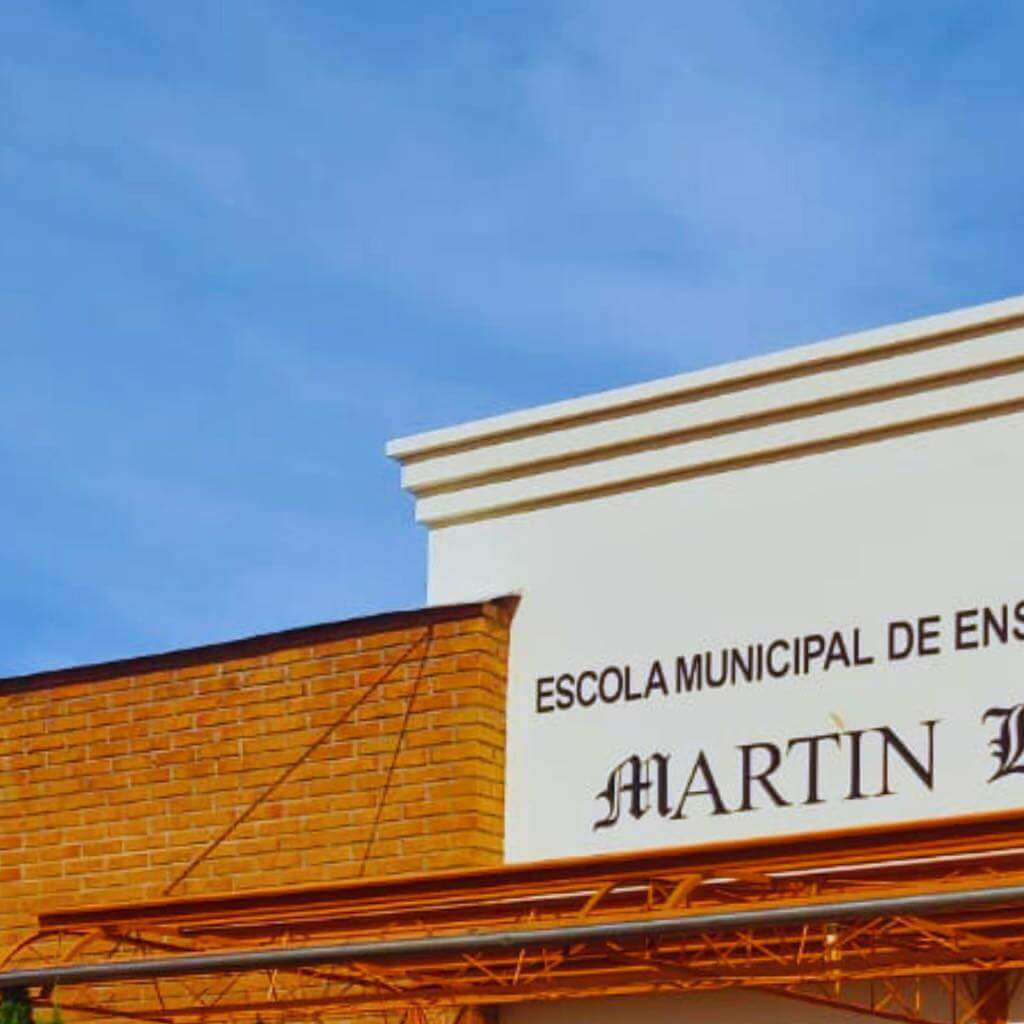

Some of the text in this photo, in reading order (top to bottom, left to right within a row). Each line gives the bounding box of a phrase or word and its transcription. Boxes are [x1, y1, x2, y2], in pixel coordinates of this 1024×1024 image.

[536, 660, 669, 713] ESCOLA
[675, 628, 874, 693] MUNICIPAL
[888, 615, 942, 661] DE
